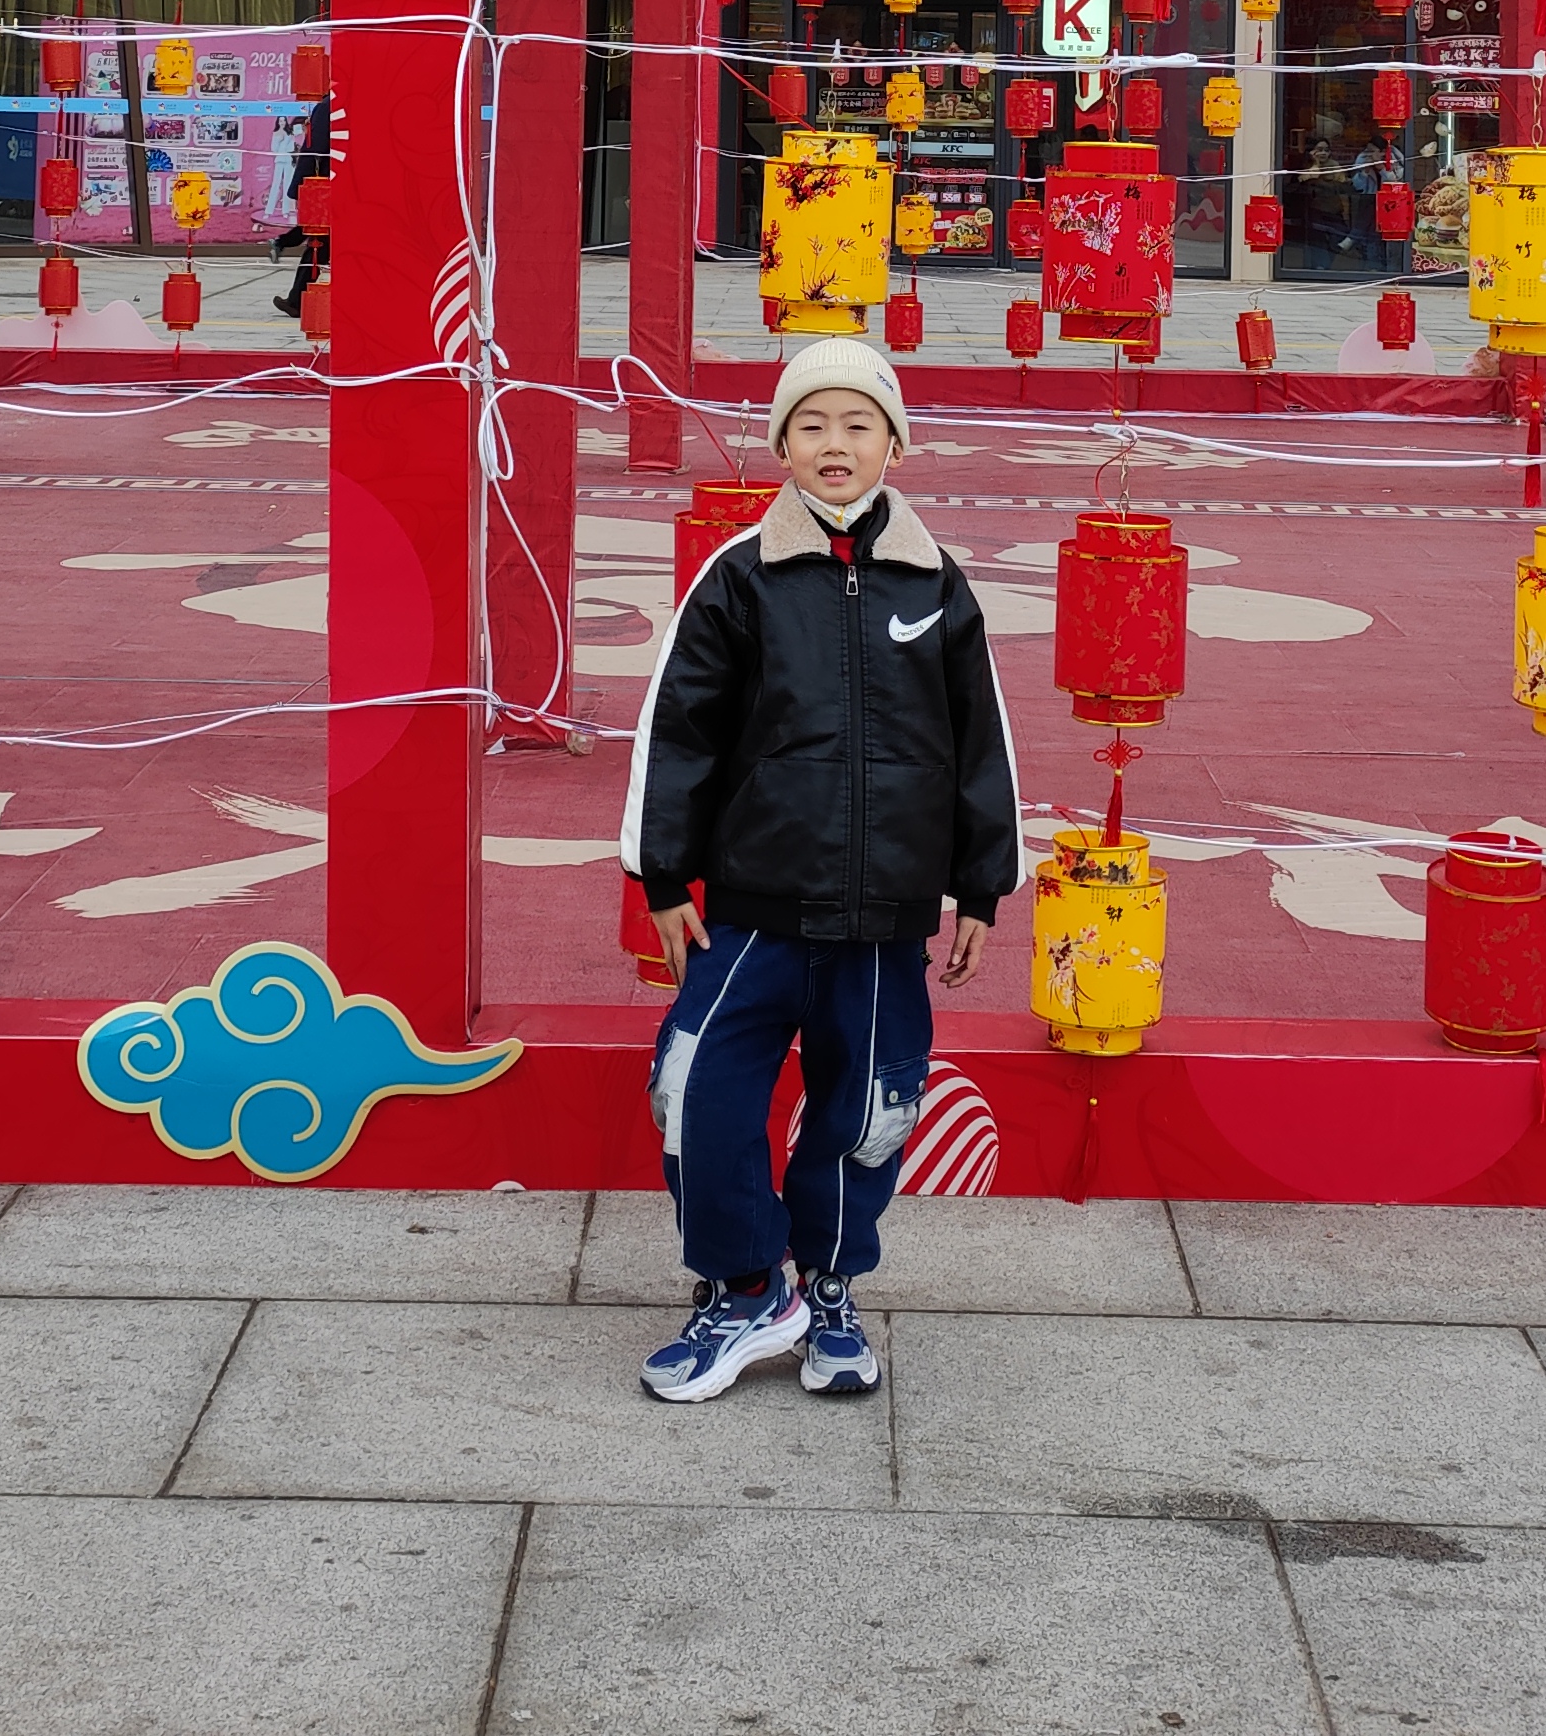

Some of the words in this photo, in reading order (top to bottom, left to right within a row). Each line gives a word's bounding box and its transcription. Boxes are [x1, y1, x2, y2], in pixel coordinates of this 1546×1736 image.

[1065, 26, 1102, 35] COFFEE
[249, 52, 292, 68] 2024
[940, 144, 964, 153] KFC
[865, 163, 878, 180] 梅
[1124, 180, 1141, 200] 梅
[1518, 185, 1537, 202] 梅
[861, 216, 874, 237] 竹
[1516, 240, 1532, 257] 竹
